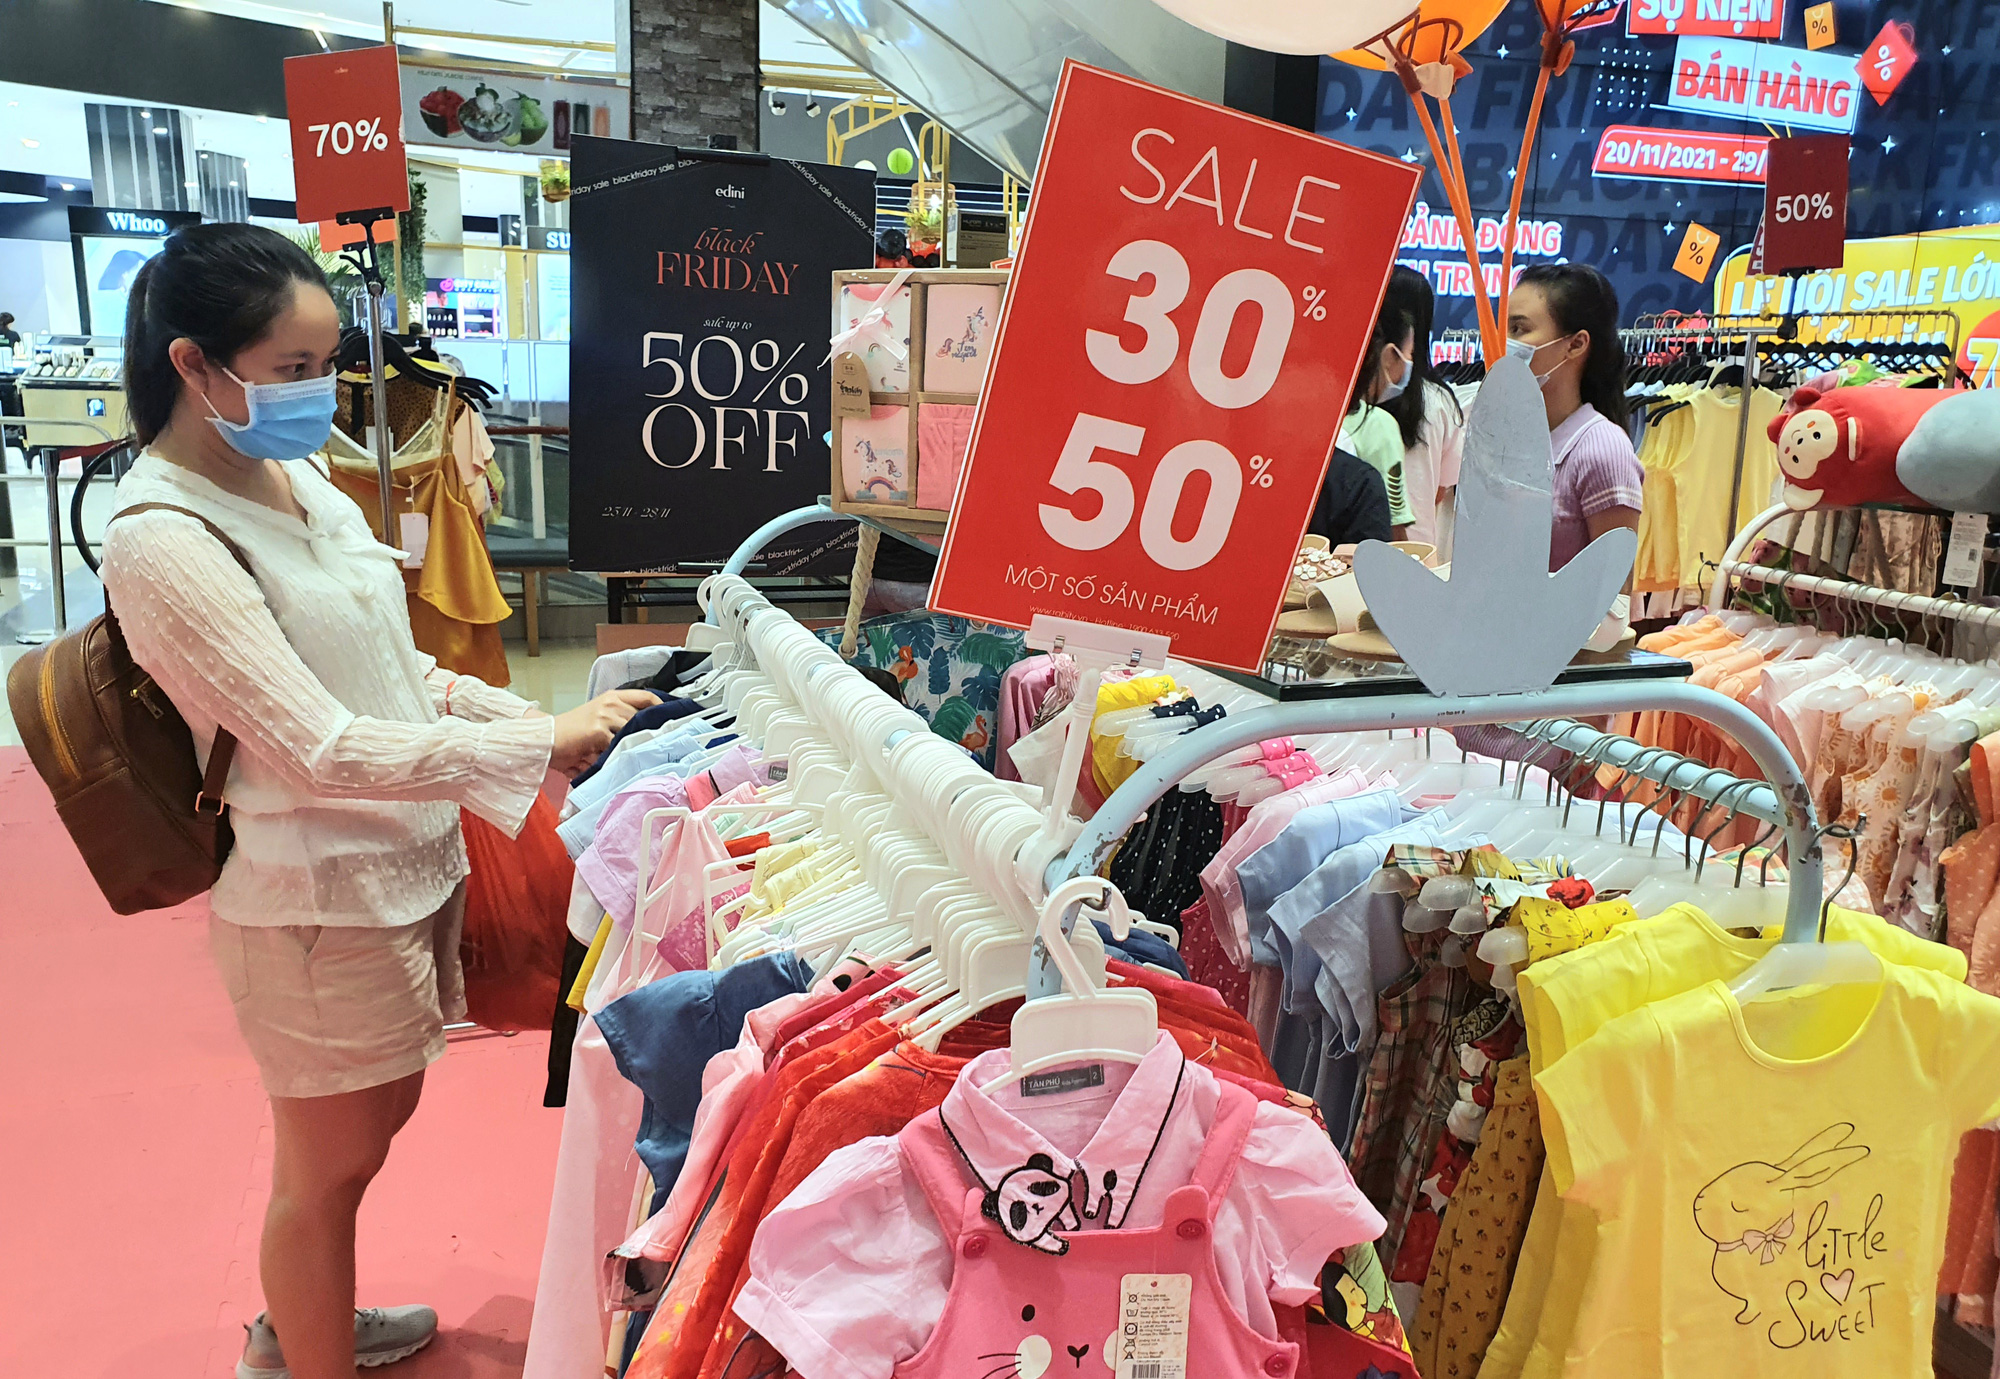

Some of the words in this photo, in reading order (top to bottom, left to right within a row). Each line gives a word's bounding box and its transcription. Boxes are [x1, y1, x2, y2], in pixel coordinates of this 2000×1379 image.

[1676, 50, 1752, 104] BÁN
[1755, 61, 1851, 117] HÀNG
[308, 117, 388, 157] 70%
[1604, 139, 1716, 170] 20/11/2021
[592, 180, 610, 190] sale
[612, 168, 658, 185] blackfriday
[658, 162, 675, 173] sale
[715, 184, 745, 199] edini
[1119, 127, 1341, 254] SALE
[106, 211, 168, 233] Whoo
[818, 184, 833, 198] sale
[833, 197, 868, 230] blackfriday
[1775, 191, 1833, 223] 50%
[694, 227, 764, 254] black
[656, 251, 799, 295] FRIDAY
[1850, 267, 1940, 311] SALE
[703, 316, 726, 328] sale
[725, 320, 740, 332] up
[643, 331, 809, 405] 50%
[642, 403, 811, 473] OFF
[1005, 564, 1060, 594] MỘT
[1062, 575, 1097, 600] SỐ
[1100, 581, 1147, 611] SẢN
[1151, 593, 1219, 625] PHẨM
[1092, 1071, 1098, 1080] 2
